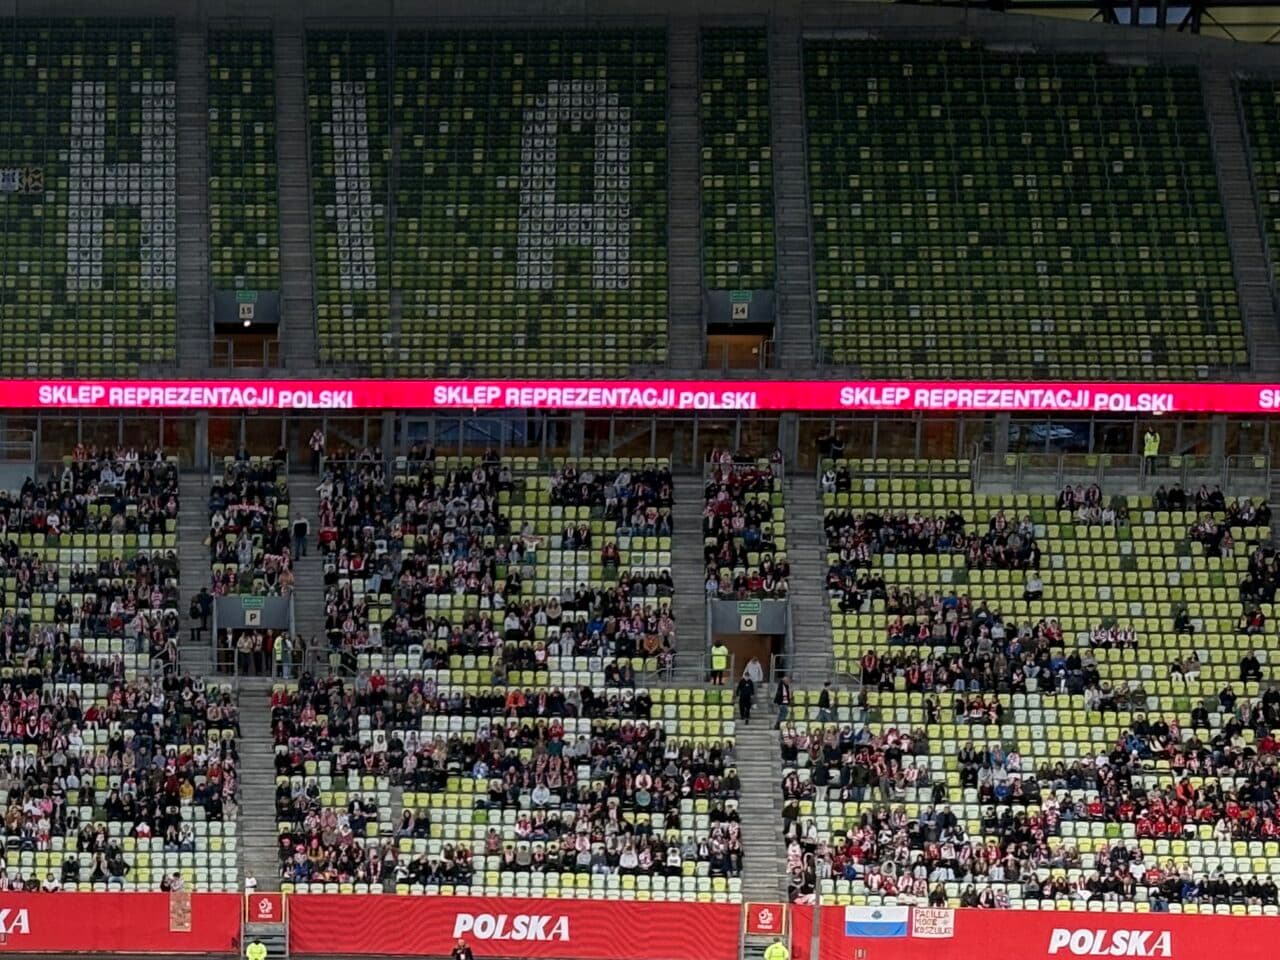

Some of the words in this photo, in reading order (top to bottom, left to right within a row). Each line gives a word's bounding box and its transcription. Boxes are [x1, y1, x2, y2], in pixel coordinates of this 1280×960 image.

[39, 385, 105, 406] SKLEP
[109, 387, 274, 407] REPREZENTACJI
[277, 390, 353, 409] POLSKI
[433, 386, 501, 406] SKLEP
[505, 388, 677, 408] REPREZENTACJI
[679, 391, 757, 410] POLSKI
[840, 386, 911, 406] SKLEP
[914, 388, 1090, 409] REPREZENTACJI
[1093, 393, 1174, 413] POLSKI
[453, 914, 569, 941] POLSKA
[1048, 928, 1174, 956] POLSKA
